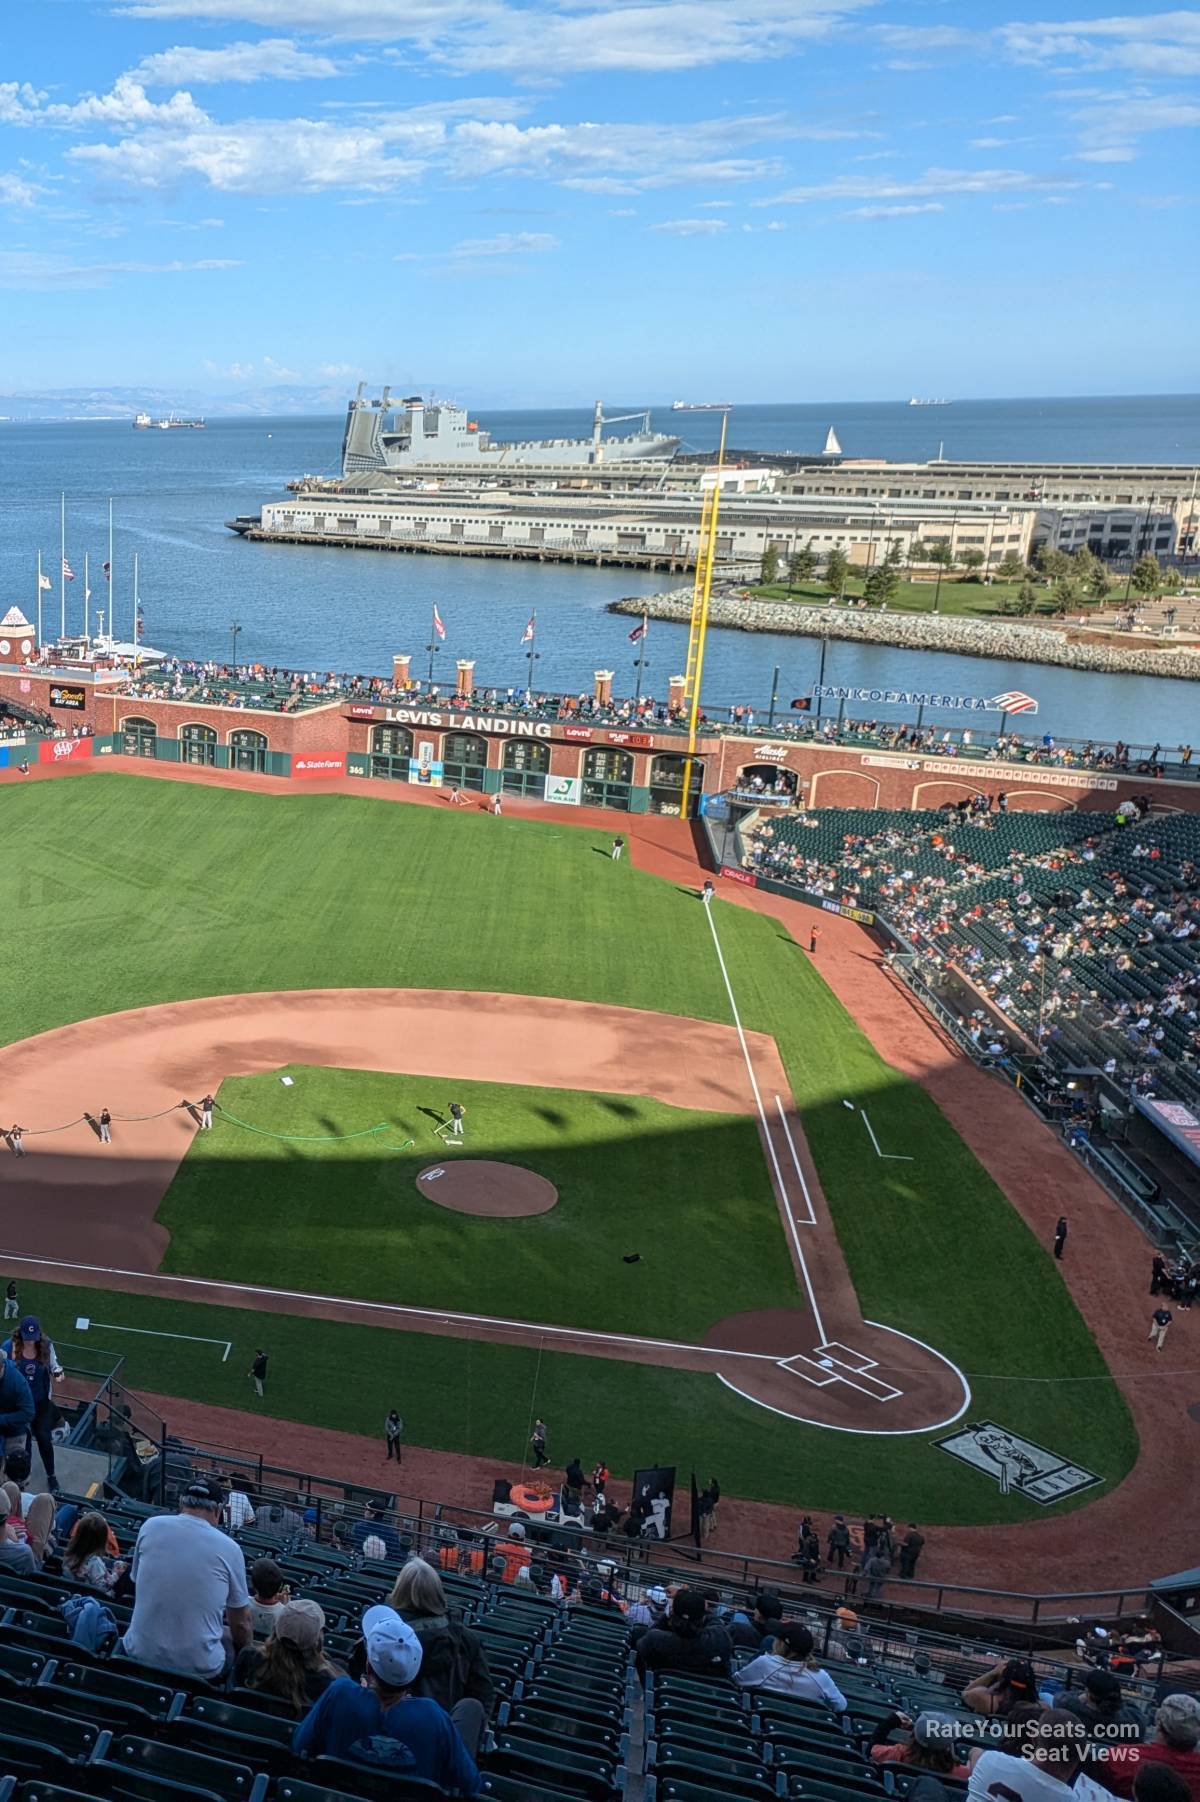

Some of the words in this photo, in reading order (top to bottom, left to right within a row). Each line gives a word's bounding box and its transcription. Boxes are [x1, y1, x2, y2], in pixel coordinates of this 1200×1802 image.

[60, 689, 85, 701] Sports
[813, 685, 863, 699] BANK
[869, 690, 893, 702] OF
[898, 692, 987, 710] AMERICA
[352, 707, 373, 715] Levi's
[386, 708, 442, 726] Levi's
[449, 715, 551, 738] LANDING
[566, 728, 591, 738] Levi's
[609, 732, 629, 740] SPLASH
[54, 741, 72, 755] AAA
[753, 744, 789, 757] Alaska
[349, 766, 364, 775] 365
[661, 805, 680, 815] 309
[723, 869, 751, 884] ORACLE
[822, 900, 841, 913] KNBR
[28, 1325, 35, 1333] C
[1027, 1468, 1088, 1498] MAYS
